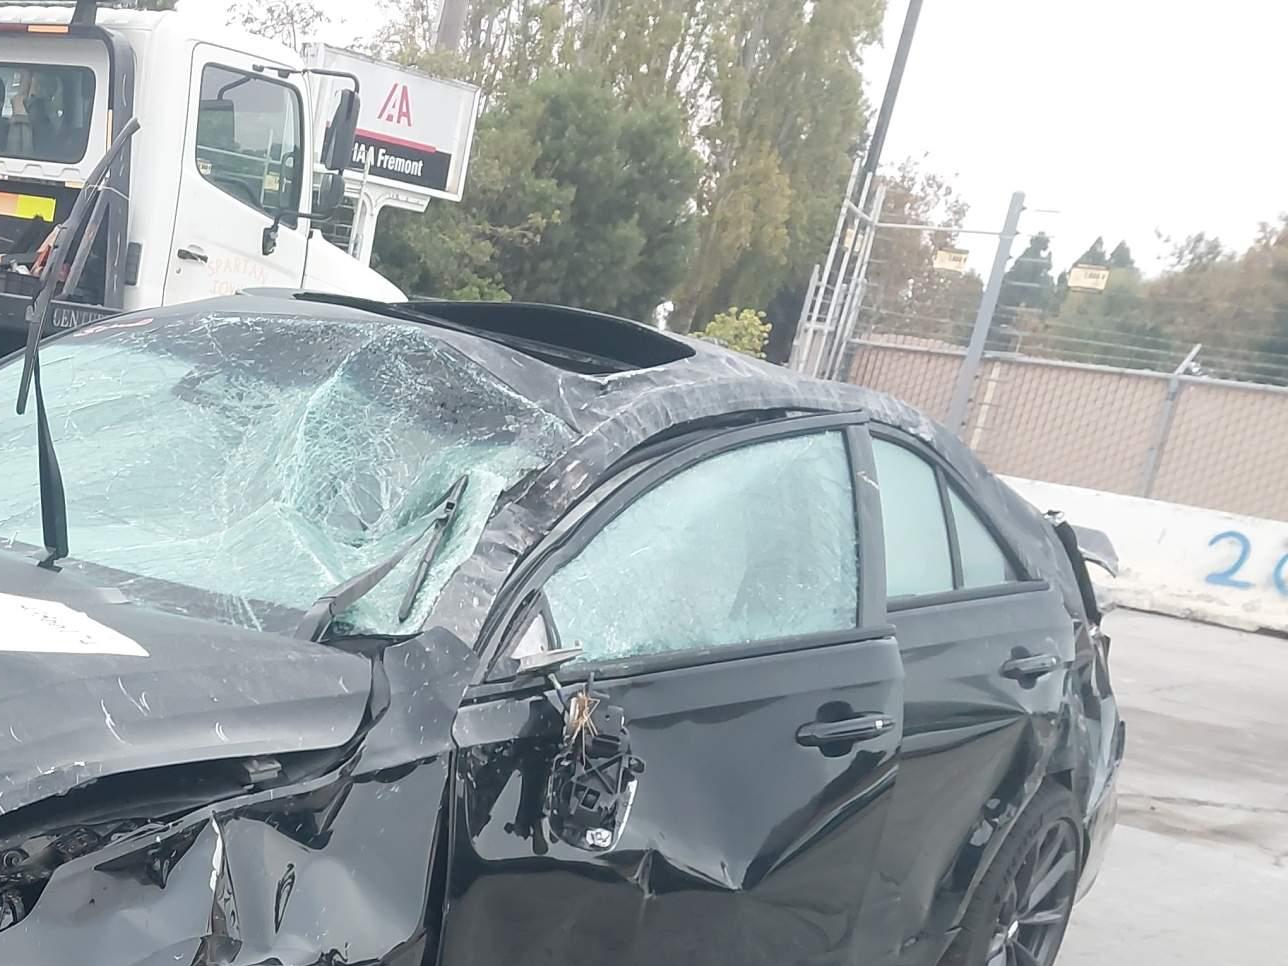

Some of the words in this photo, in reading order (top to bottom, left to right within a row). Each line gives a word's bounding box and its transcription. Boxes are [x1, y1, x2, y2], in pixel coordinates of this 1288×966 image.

[352, 142, 375, 166] IAA
[377, 148, 424, 177] Fremont
[208, 257, 265, 284] SPARTAN
